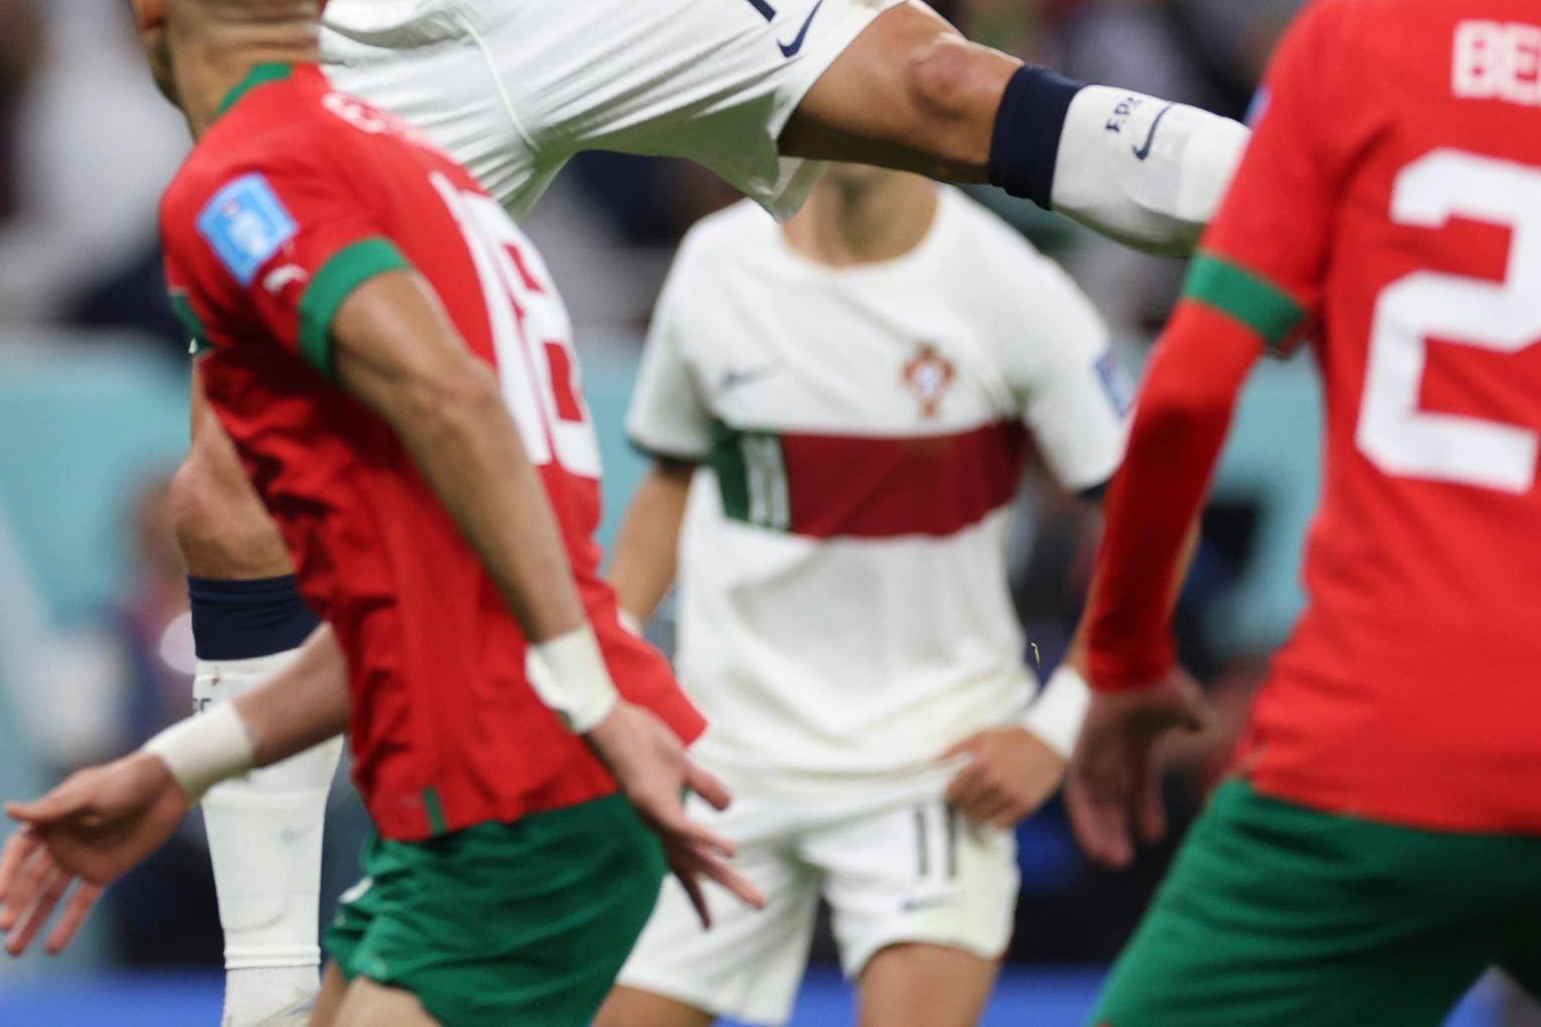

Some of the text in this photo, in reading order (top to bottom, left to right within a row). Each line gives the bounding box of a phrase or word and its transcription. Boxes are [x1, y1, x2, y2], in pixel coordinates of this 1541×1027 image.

[428, 171, 605, 480] 18
[741, 436, 790, 528] 11
[912, 802, 960, 880] 11
